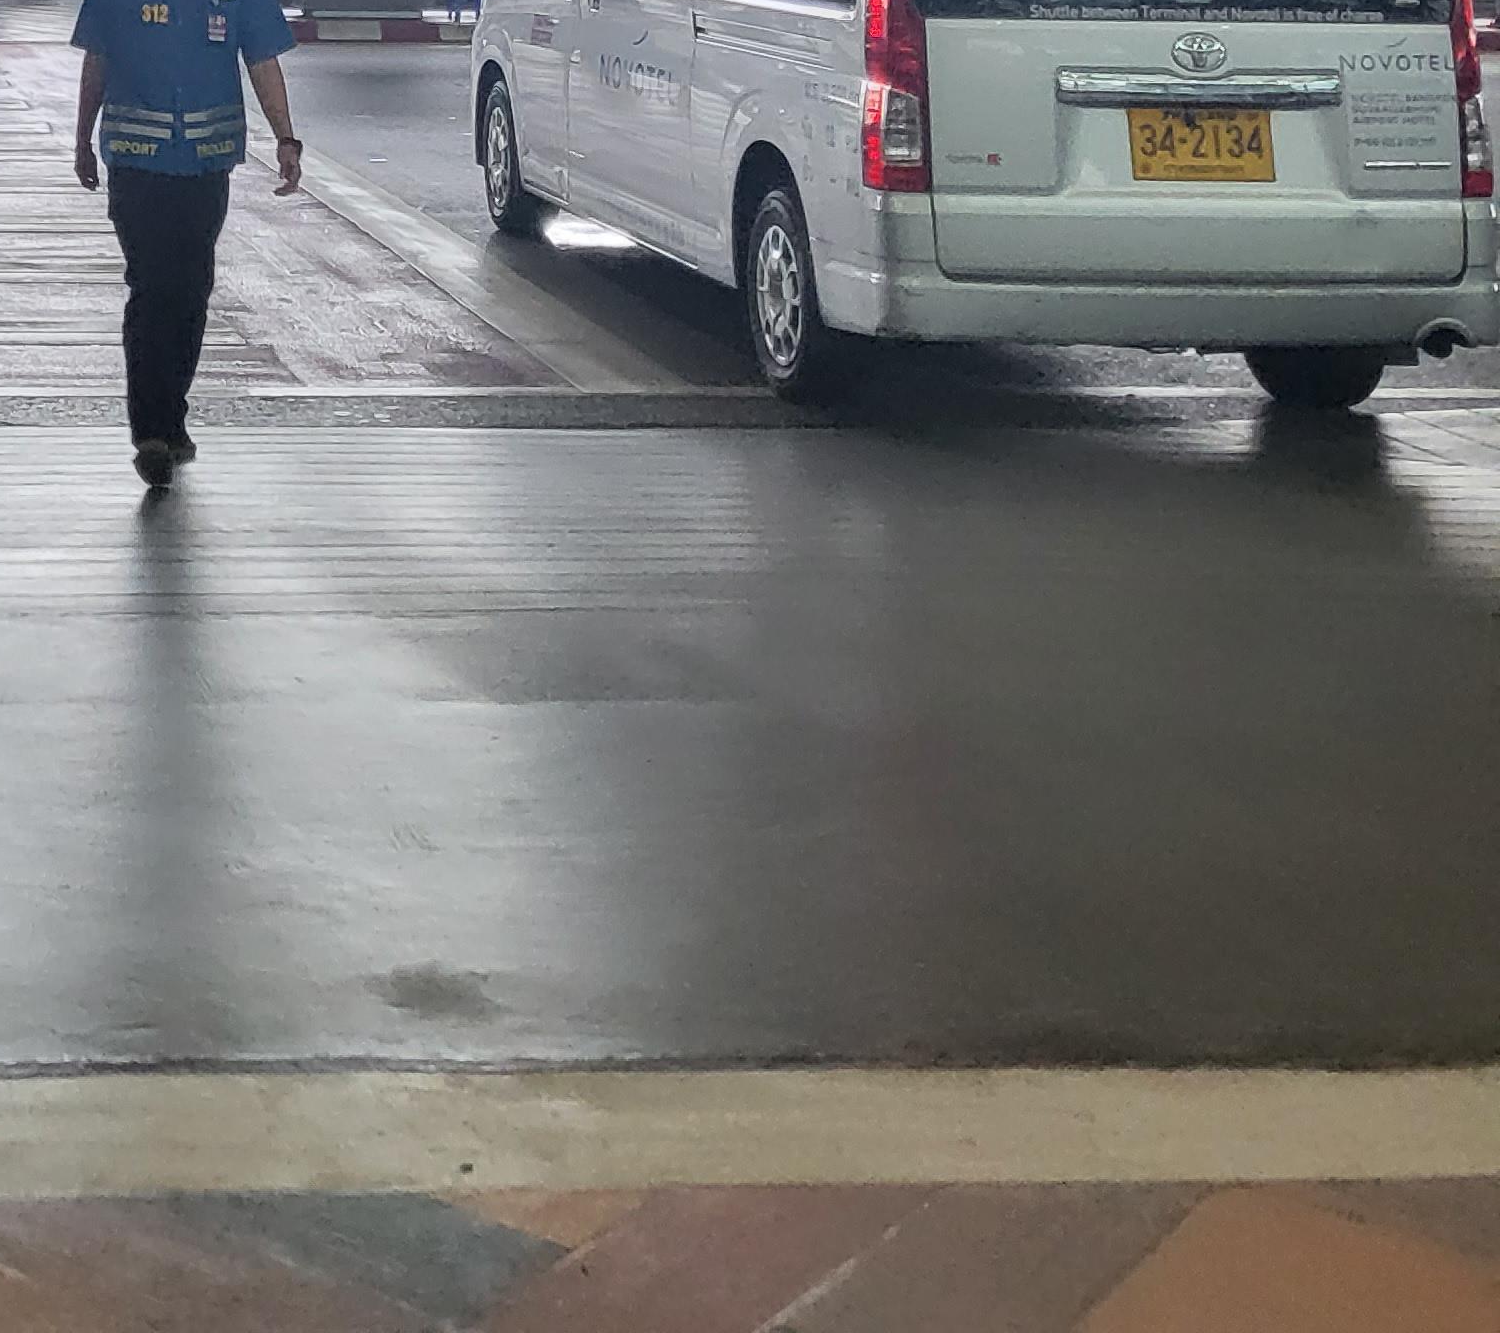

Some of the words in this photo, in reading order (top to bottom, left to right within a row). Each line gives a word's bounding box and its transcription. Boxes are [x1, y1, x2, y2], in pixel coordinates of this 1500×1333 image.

[1029, 4, 1079, 19] Shuttle
[1081, 5, 1138, 20] between
[1140, 4, 1201, 20] Terminal
[1203, 6, 1229, 21] and
[1339, 54, 1456, 72] NOVOTEL
[1139, 123, 1264, 160] 34-2134
